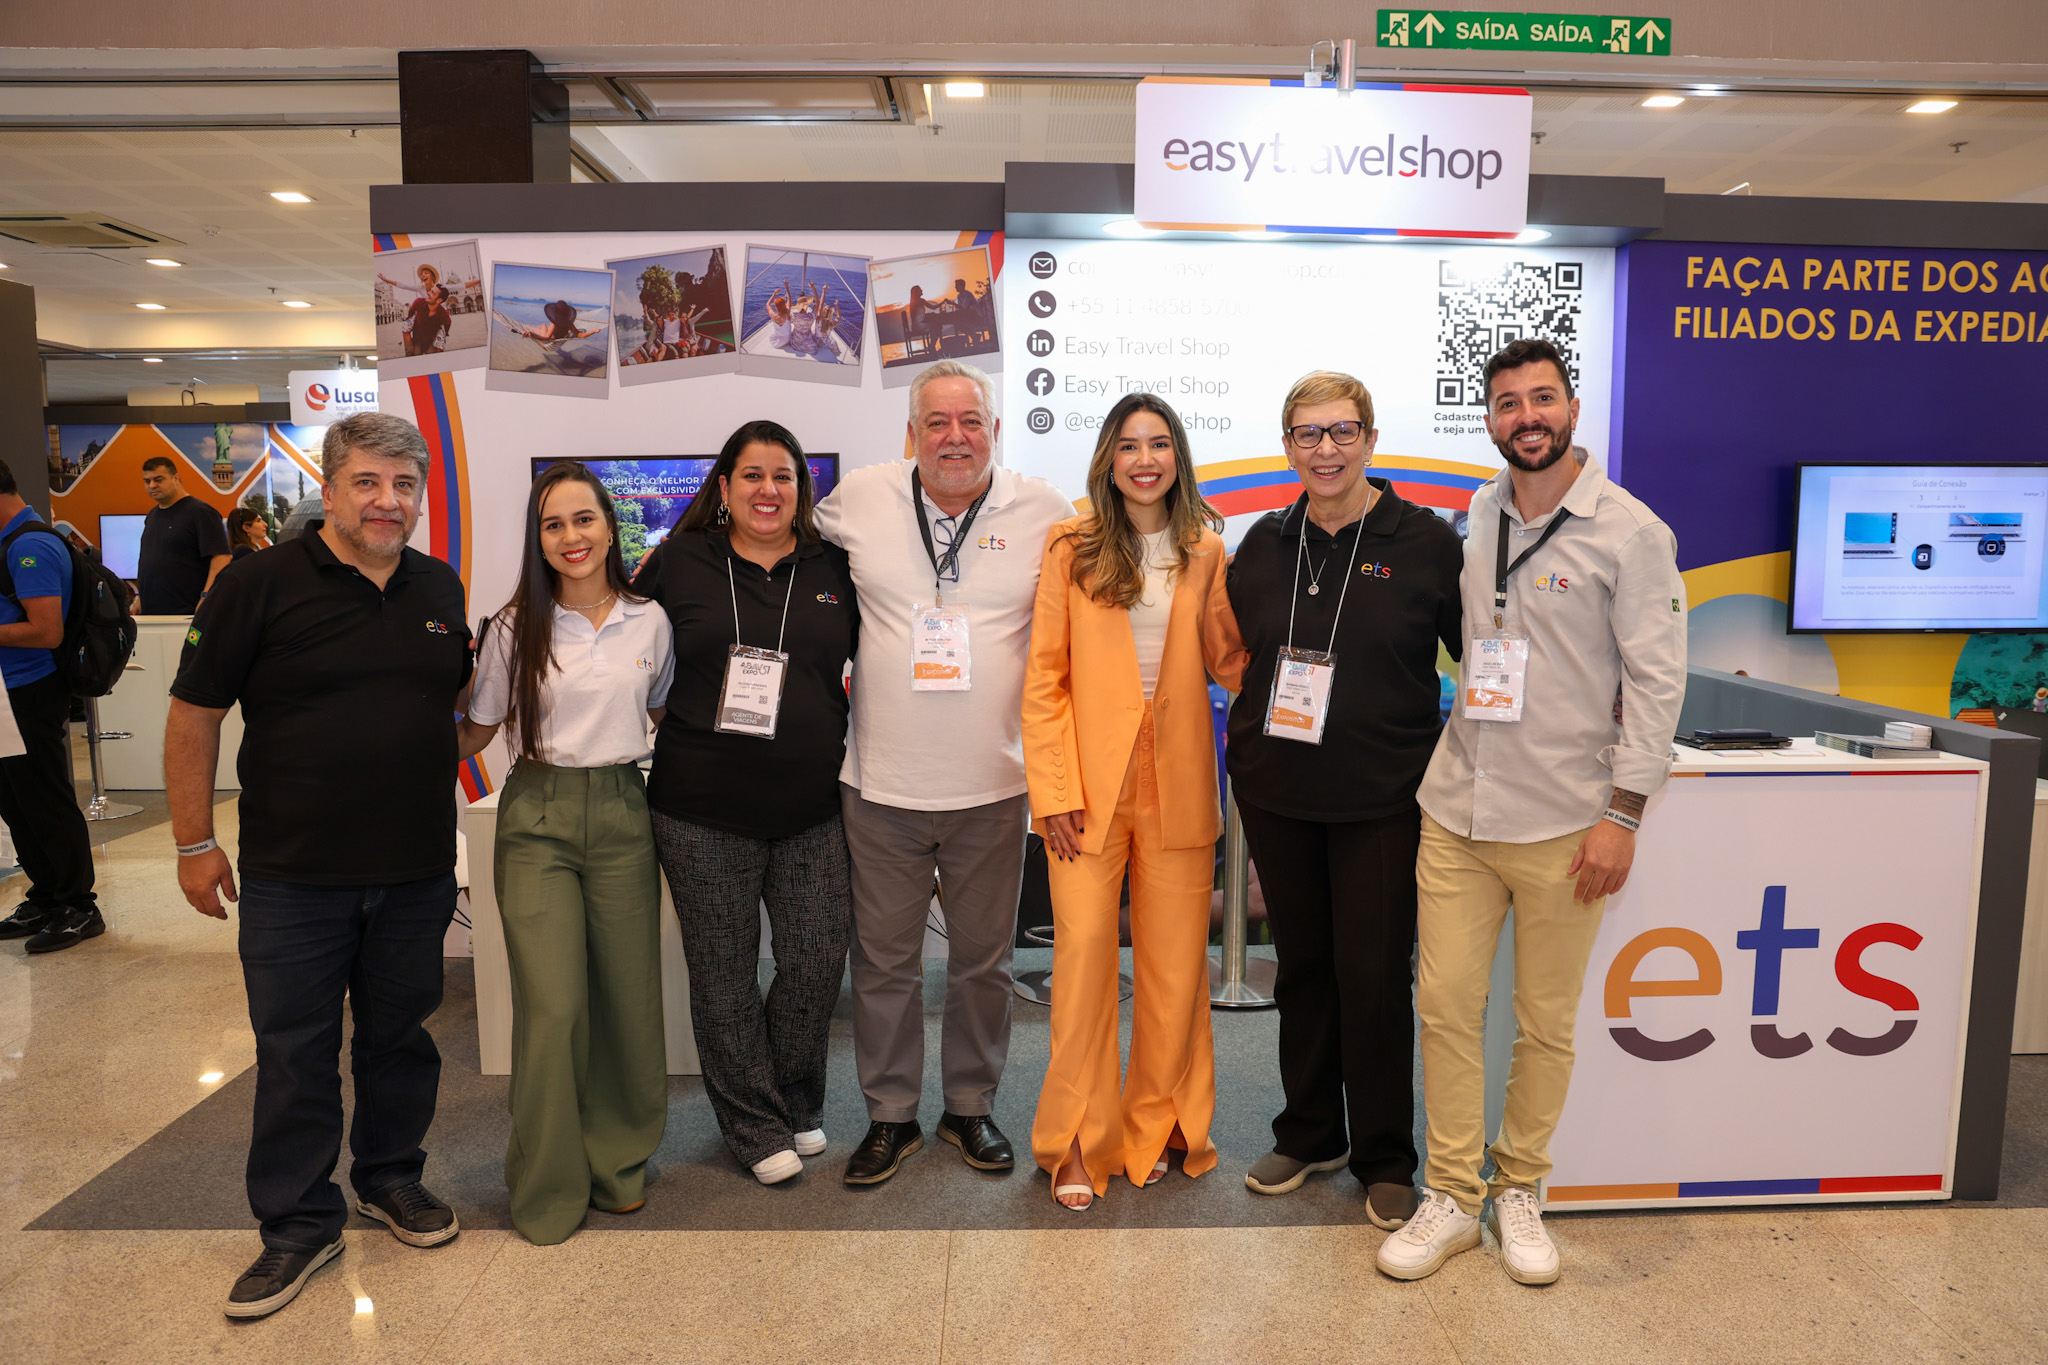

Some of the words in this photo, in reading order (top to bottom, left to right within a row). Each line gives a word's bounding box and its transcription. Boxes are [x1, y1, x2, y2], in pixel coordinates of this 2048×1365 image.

[1455, 18, 1520, 41] SAÍDA
[1530, 20, 1594, 43] SAÍDA
[1686, 256, 1790, 297] FAÇA
[1802, 258, 1910, 292] PARTE
[1922, 260, 1999, 294] DOS
[1673, 306, 1836, 341] FILIADOS
[1849, 309, 1901, 341] DA
[1065, 336, 1110, 358] Easy
[1115, 336, 1173, 355] Travel
[1180, 337, 1230, 359] Shop
[1065, 375, 1110, 397] Easy
[1115, 375, 1172, 394] Travel
[1180, 376, 1229, 398] Shop
[1443, 425, 1467, 435] seja
[600, 477, 647, 486] CONHEÇA
[659, 477, 700, 485] MELHOR
[1938, 480, 1967, 488] Conexão
[616, 487, 638, 495] COM
[977, 534, 1006, 551] ets
[1361, 561, 1392, 579] ets
[1536, 573, 1569, 593] ets
[816, 591, 838, 605] ets
[426, 618, 449, 635] ets
[636, 657, 654, 673] ets
[1603, 885, 1924, 1062] ets
